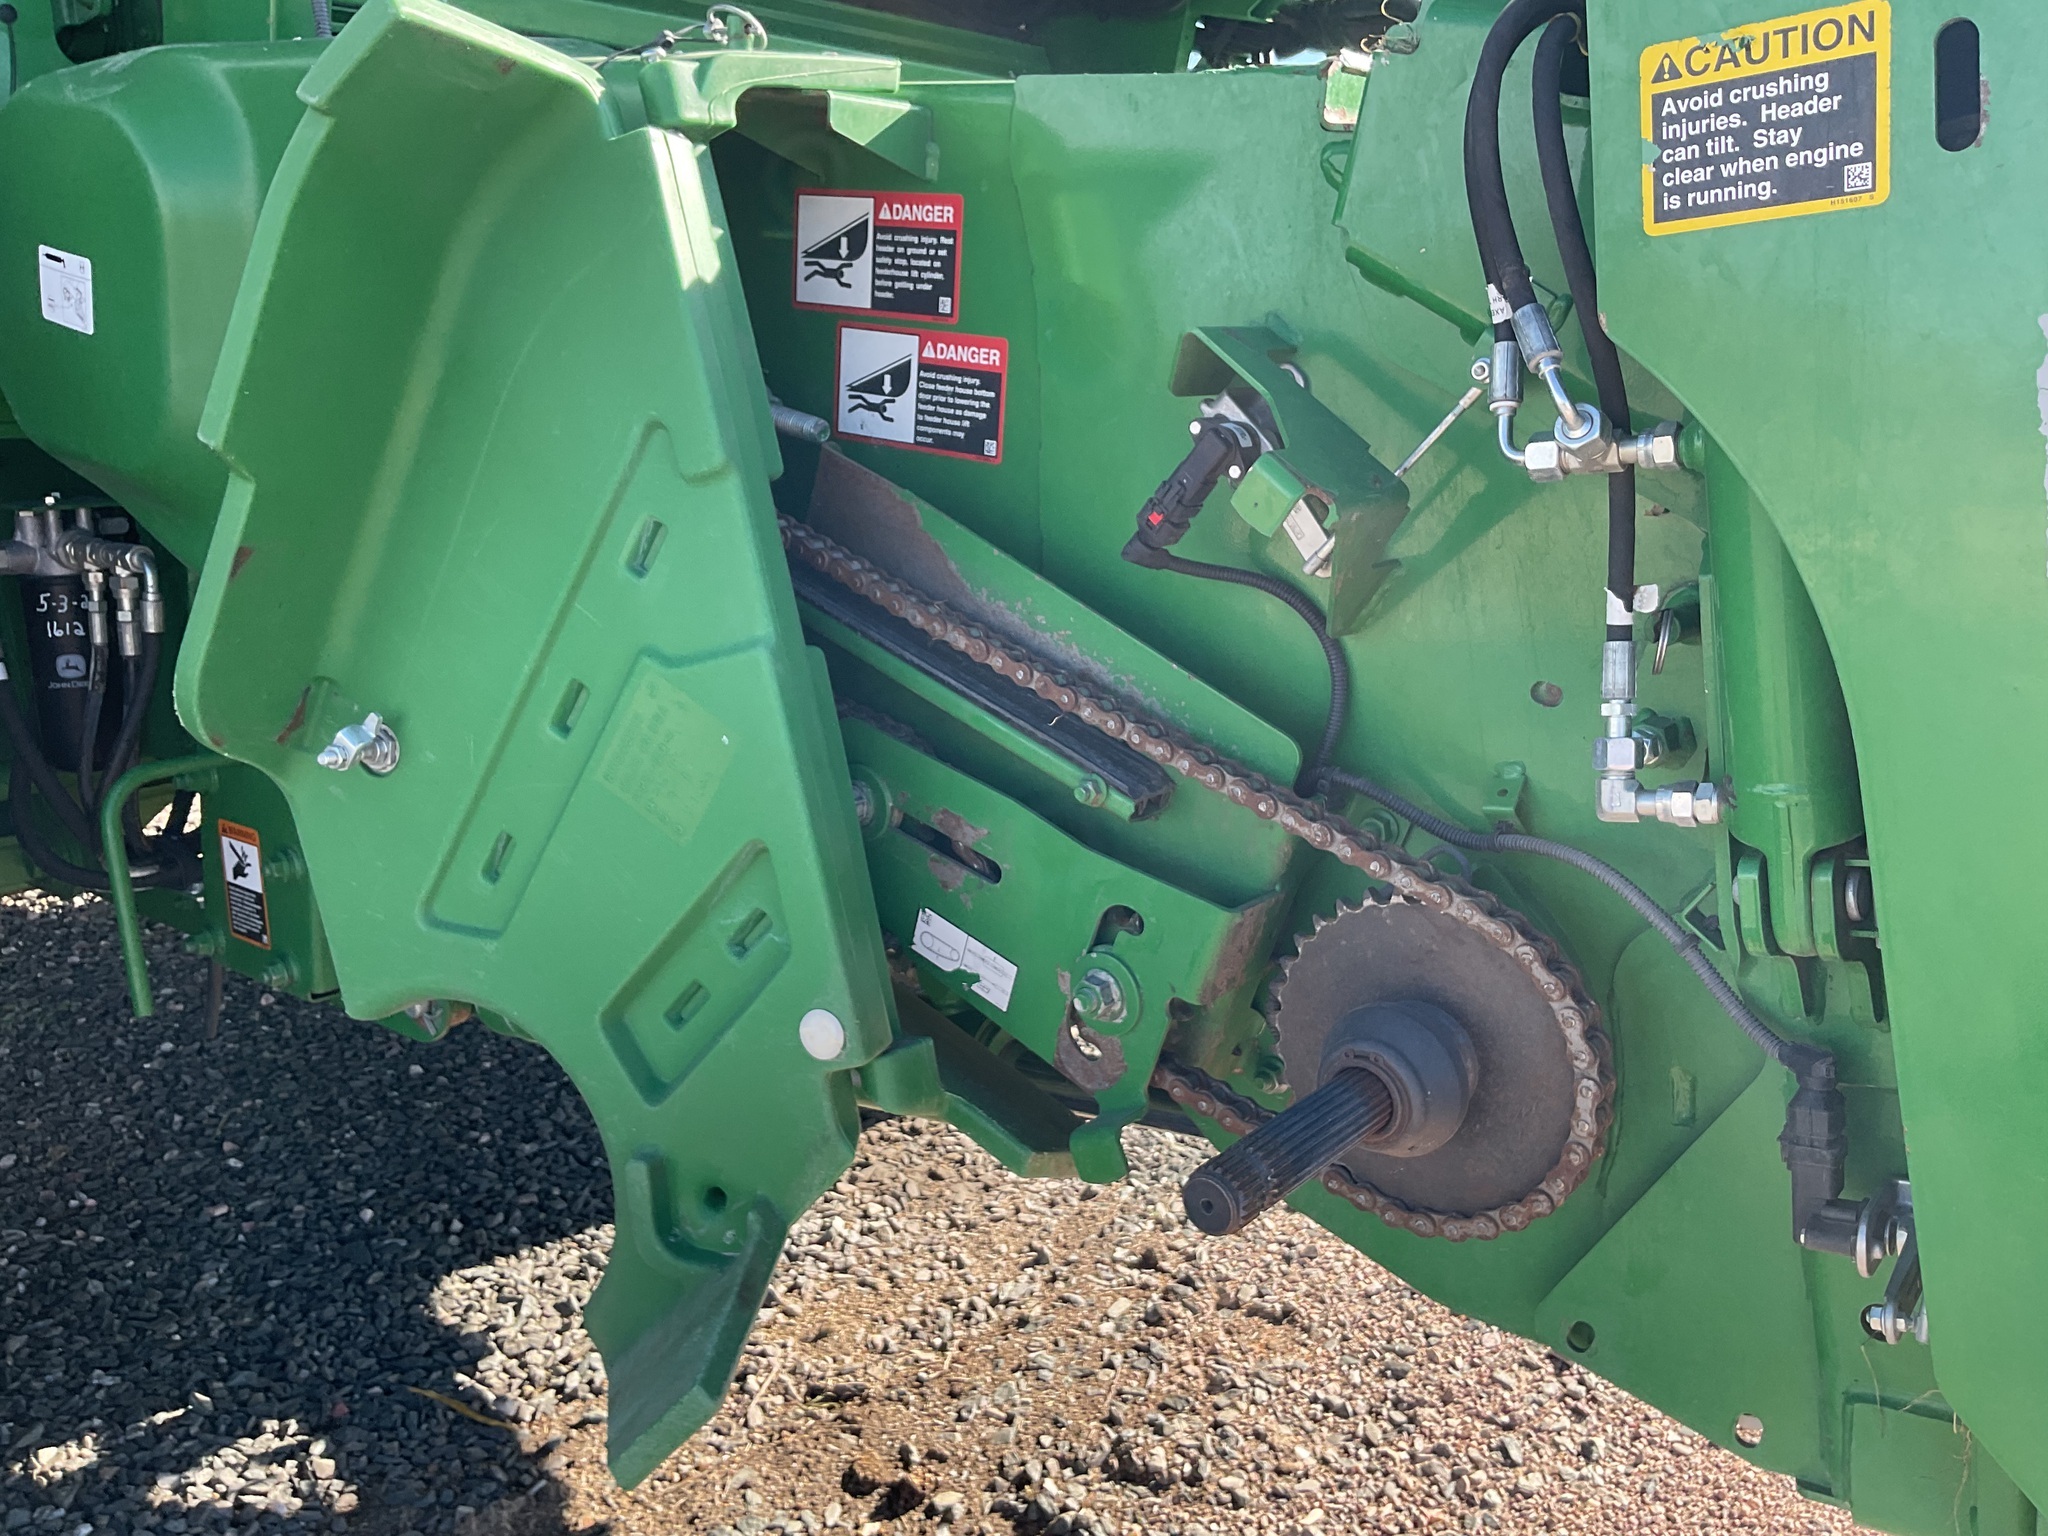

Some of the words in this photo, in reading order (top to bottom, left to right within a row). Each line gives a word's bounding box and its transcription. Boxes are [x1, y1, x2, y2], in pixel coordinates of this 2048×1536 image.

[1685, 10, 1875, 76] CAUTION
[1661, 87, 1723, 117] Avoid
[1729, 72, 1829, 104] crushing
[1662, 112, 1747, 142] injuries.
[1761, 95, 1842, 122] Header
[1662, 144, 1699, 163] can
[1705, 135, 1739, 156] tilt.
[1753, 126, 1803, 148] Stay
[1662, 165, 1715, 187] clear
[1719, 155, 1779, 178] when
[1785, 142, 1864, 168] engine
[1663, 192, 1681, 210] is
[1687, 180, 1777, 207] running.
[892, 203, 955, 223] DANGER
[876, 232, 892, 241] Avoid
[894, 234, 919, 244] crushing
[936, 342, 1001, 366] DANGER
[919, 370, 936, 378] Avoid
[936, 373, 962, 384] crushing
[919, 380, 936, 390] Close
[963, 409, 987, 420] damage
[46, 620, 86, 638] 1612
